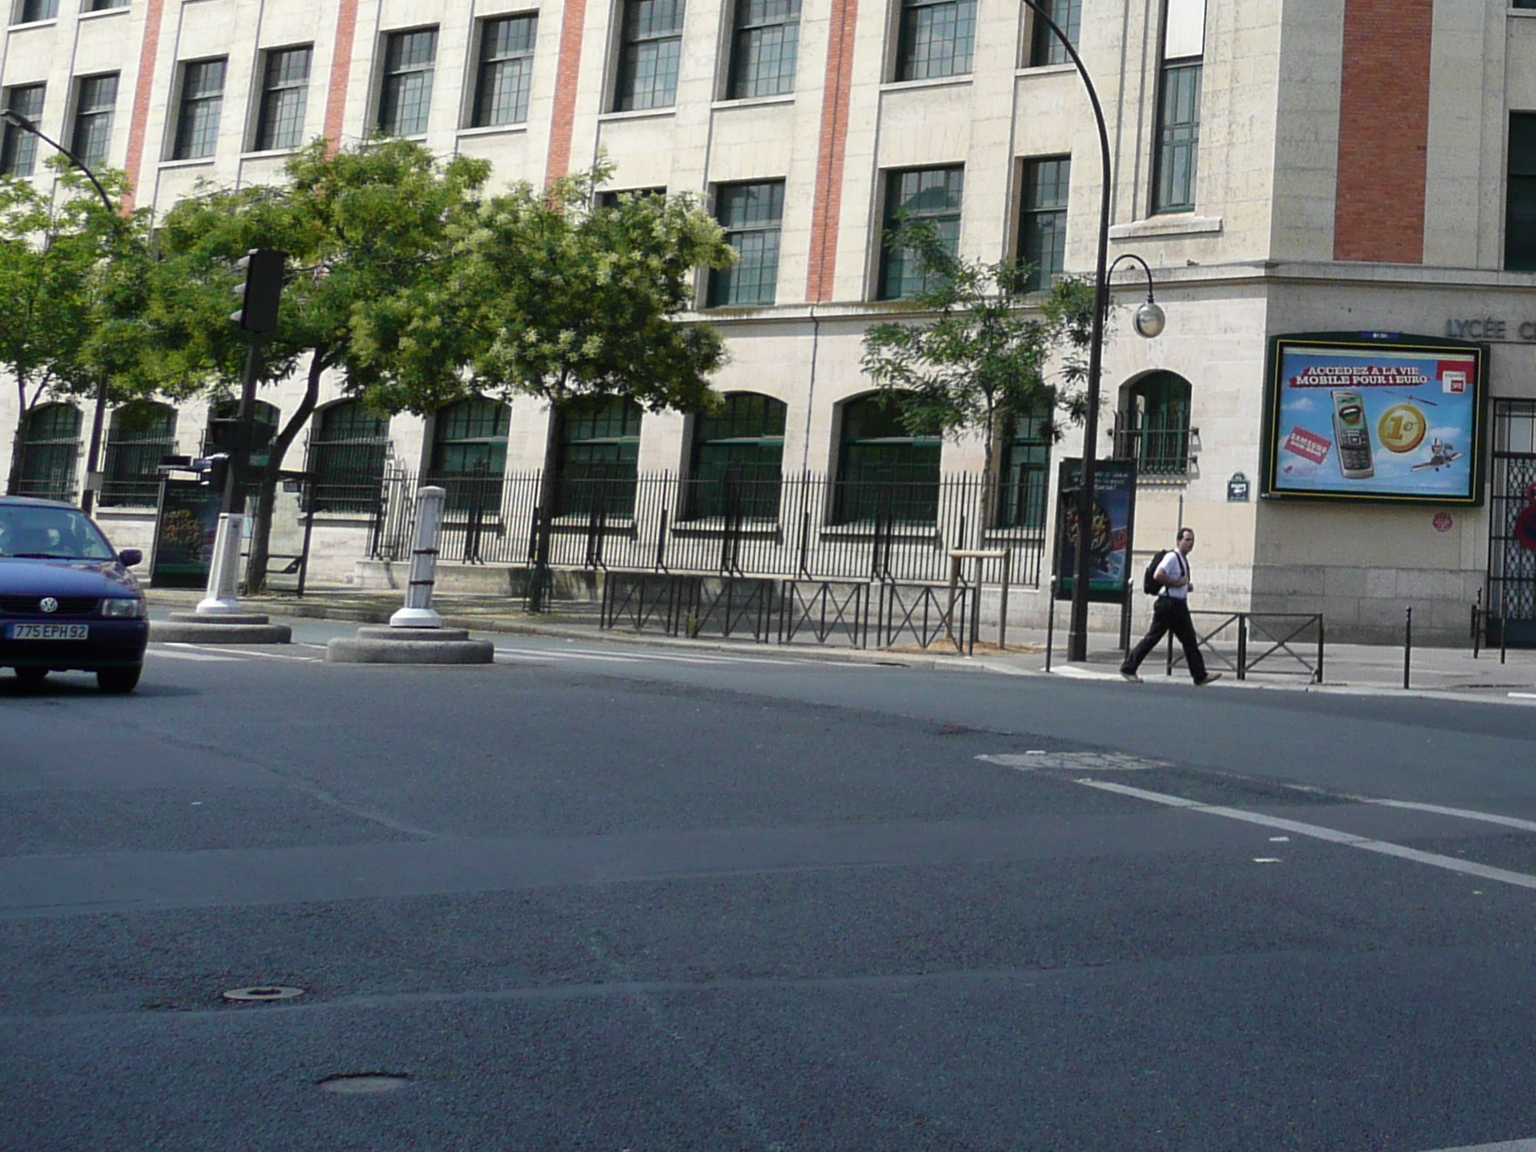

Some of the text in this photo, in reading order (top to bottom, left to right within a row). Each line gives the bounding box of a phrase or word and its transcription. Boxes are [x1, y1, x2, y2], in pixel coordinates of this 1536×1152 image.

[1446, 317, 1505, 339] LYCÉE
[1382, 367, 1397, 376] LA
[1400, 367, 1420, 376] VIE
[1296, 375, 1350, 385] MOBILE
[1352, 375, 1387, 385] POUR
[1397, 374, 1428, 384] EURO
[16, 625, 86, 638] 775 EPH 92
